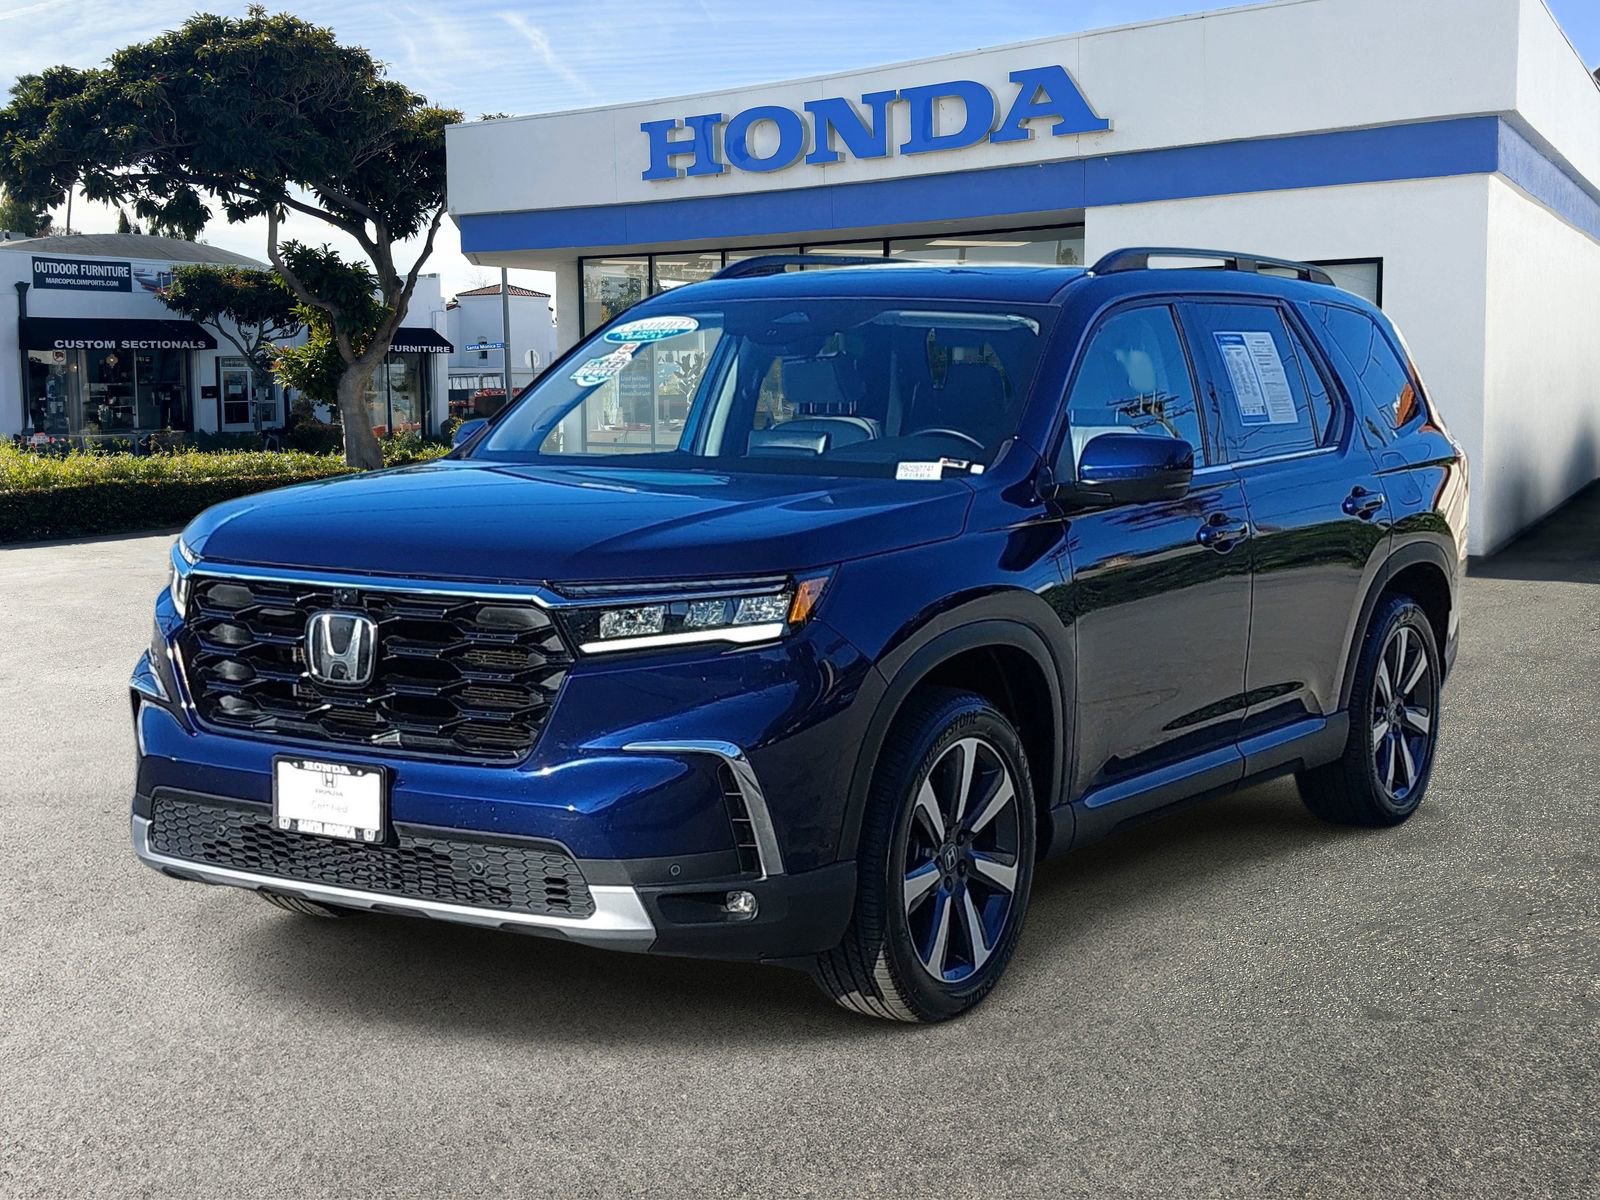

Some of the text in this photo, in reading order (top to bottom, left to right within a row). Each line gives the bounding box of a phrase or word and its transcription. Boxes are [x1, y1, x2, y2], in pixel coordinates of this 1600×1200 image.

[640, 64, 1112, 182] HONDA
[34, 261, 130, 278] OUTDOOR FURNITURE
[45, 277, 119, 287] MARCOPOLOIMPORTS.COM
[54, 340, 206, 349] CUSTOM SECTIONALS
[388, 344, 450, 353] FURNITURE
[303, 761, 351, 775] HONDA
